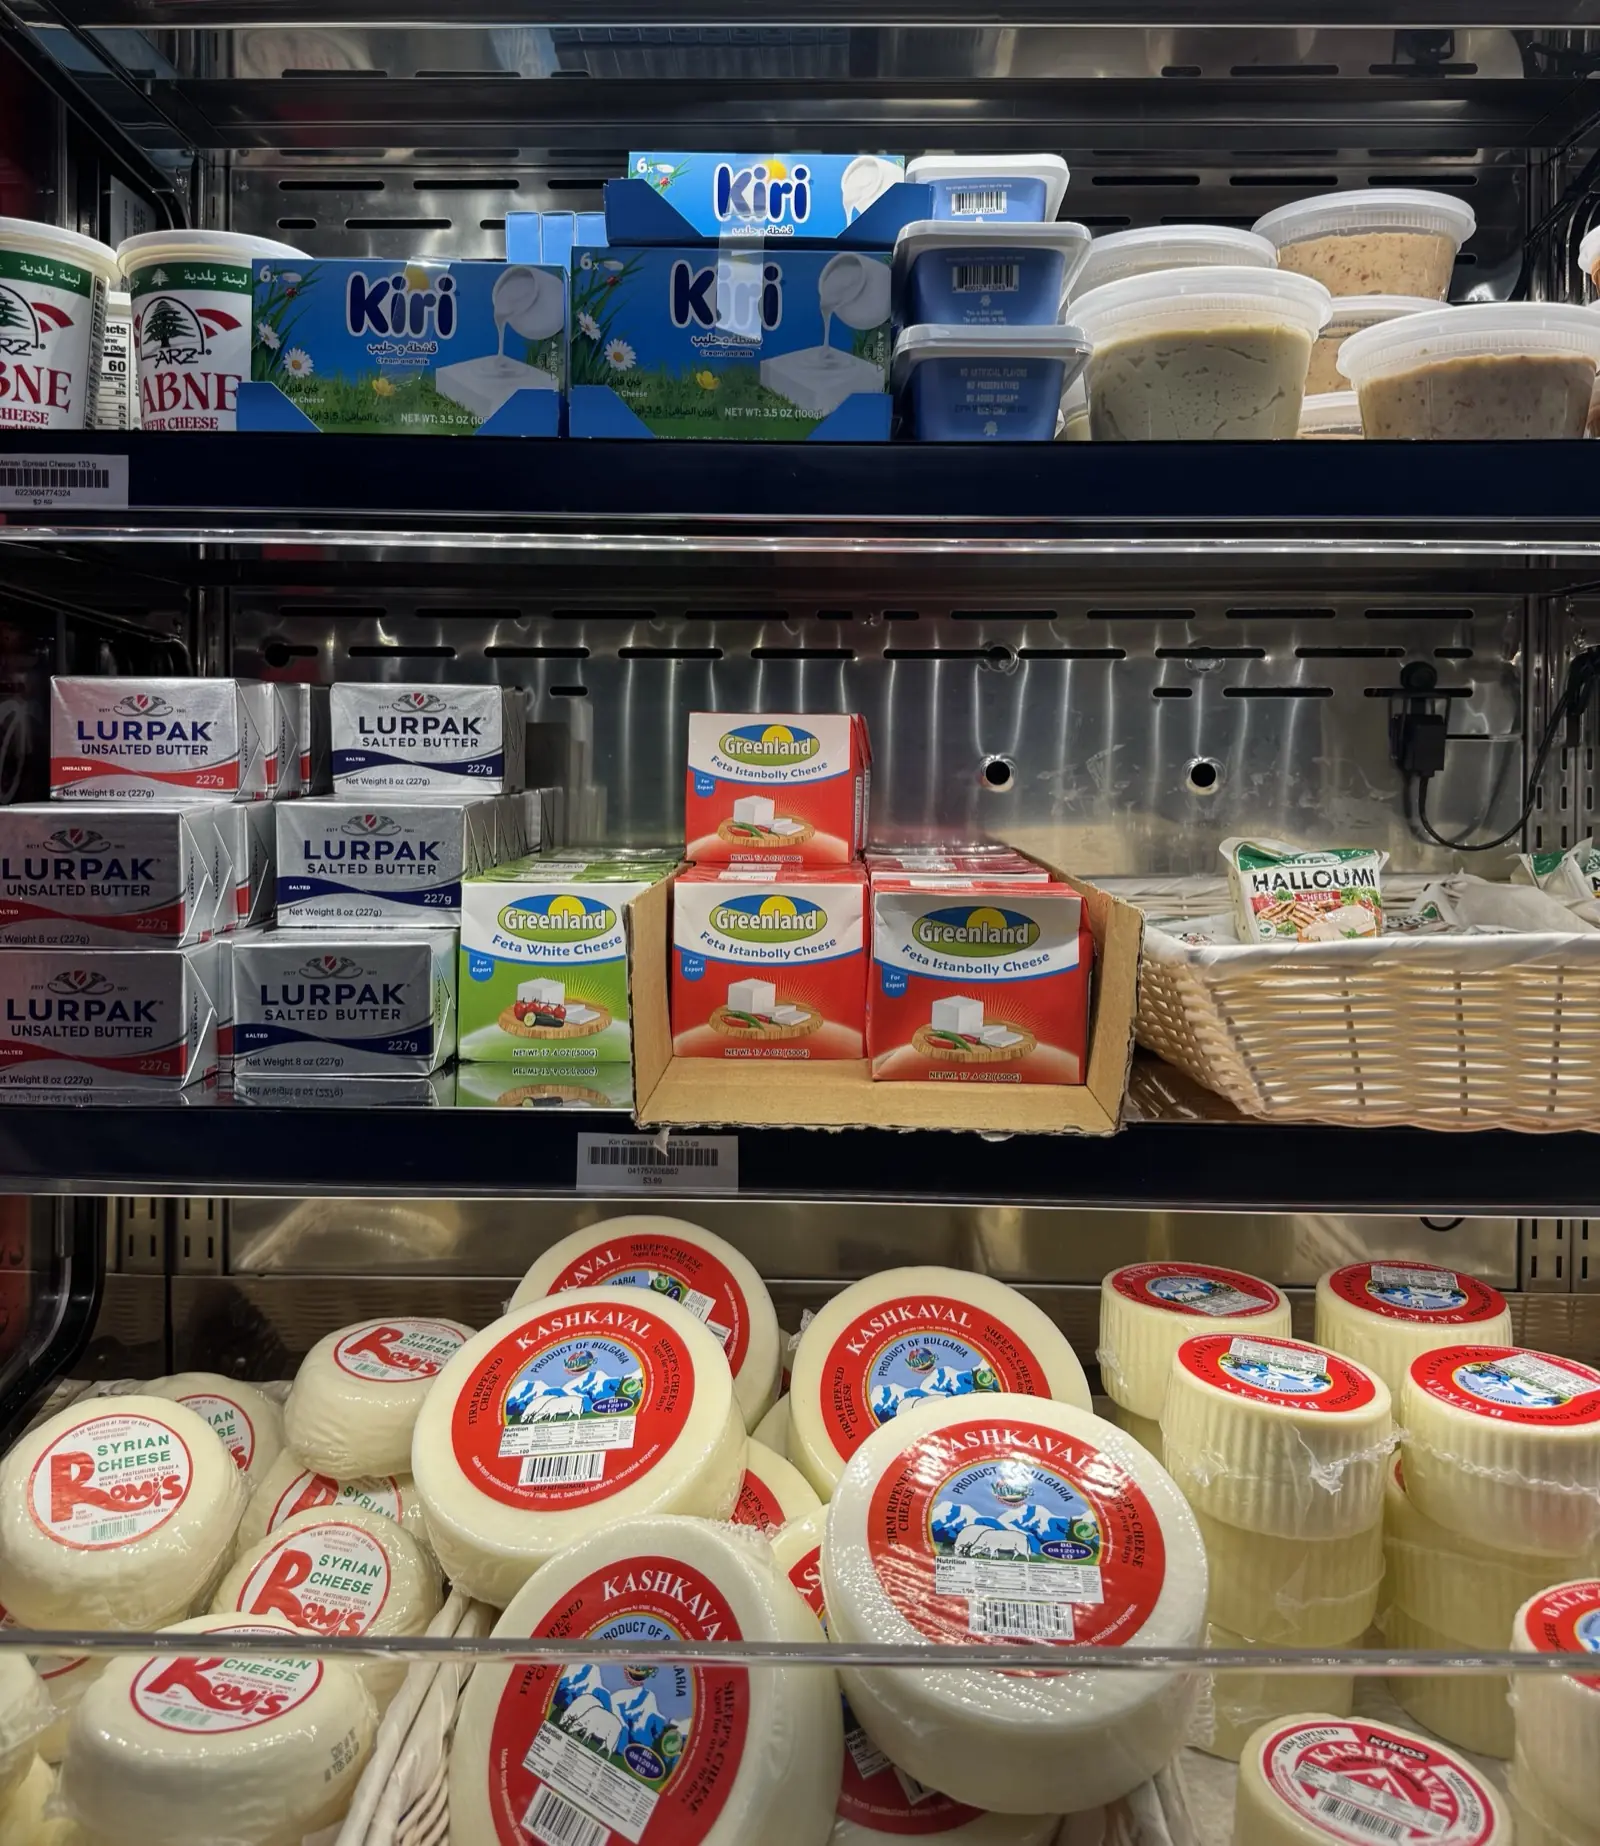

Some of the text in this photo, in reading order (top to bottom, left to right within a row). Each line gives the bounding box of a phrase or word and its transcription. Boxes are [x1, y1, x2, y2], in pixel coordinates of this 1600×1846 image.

[635, 157, 654, 174] 6x
[713, 162, 812, 223] Kiri
[20, 259, 81, 285] لبنة بلدية
[579, 253, 599, 270] 6x
[184, 268, 248, 286] لبنة بلدية
[259, 264, 279, 283] 6x
[346, 271, 458, 338] Kiri
[670, 259, 783, 331] Kiri
[155, 348, 199, 369] ARZ
[376, 356, 430, 366] Cream Milk
[700, 349, 724, 357] Cream
[108, 360, 126, 373] 60
[960, 368, 968, 377] NO
[621, 390, 648, 398] Cheese
[0, 408, 49, 426] HEESE
[401, 413, 469, 425] NET 3.5 OZ
[724, 407, 744, 417] NET
[763, 408, 778, 418] 3.5
[780, 408, 793, 418] OZ
[794, 408, 823, 420] (100g)
[77, 720, 213, 742] LURPAK
[359, 716, 483, 735] LURPAK
[82, 744, 209, 755] UNSALTED BUTTER
[362, 737, 479, 748] SALTED BUTTER
[724, 736, 812, 755] Greenland
[467, 764, 493, 775] 227g
[710, 755, 828, 781] Feta Istanbolly Cheese
[195, 774, 225, 786] 227g
[346, 777, 359, 785] Net
[360, 777, 387, 786] Weight
[388, 777, 394, 785] 8
[405, 777, 431, 787] (227g)
[63, 788, 77, 797] Net
[79, 788, 108, 799] Weight
[109, 788, 116, 797] 8
[128, 788, 155, 799] (227g)
[303, 840, 441, 861] LURPAK
[2, 858, 156, 881] LURPAK
[308, 863, 437, 875] SALTED BUTTER
[7, 884, 151, 896] UNSALTED BUTTER
[1252, 868, 1376, 892] HALLOUMI
[423, 893, 452, 905] 227g
[1301, 892, 1334, 901] CHEESE
[289, 908, 303, 917] Net
[305, 908, 335, 917] Weight
[336, 908, 342, 917] 8
[355, 908, 382, 917] (227g)
[504, 909, 607, 931] Greenland
[715, 909, 818, 930] Greenland
[136, 919, 168, 930] 227g
[918, 920, 1029, 944] Greenland
[5, 935, 37, 945] Weight
[60, 935, 90, 946] (227g)
[492, 934, 623, 957] Feta White Cheese
[700, 931, 837, 960] Feta Istanbolly Cheese
[902, 943, 1051, 976] Feta Istanbolly Cheese
[261, 983, 406, 1006] LURPAK
[7, 999, 158, 1023] LURPAK
[264, 1008, 401, 1021] SALTED BUTTER
[11, 1024, 153, 1038] UNSALTED BUTTER
[387, 1040, 418, 1052] 227g
[140, 1060, 171, 1072] 227g
[246, 1058, 261, 1066] Net
[262, 1057, 294, 1067] Weight
[295, 1058, 302, 1066] 8
[315, 1057, 344, 1067] (227g)
[9, 1075, 42, 1086] Weight
[63, 1075, 93, 1086] (227g)
[630, 1243, 704, 1271] SHEEP'S CHEESE
[408, 1331, 462, 1350] SYRIAN
[516, 1309, 652, 1351] KASHKAVAL
[846, 1303, 972, 1357] KASHKAVAL
[399, 1338, 451, 1356] CHEESE
[985, 1325, 1020, 1360] SHEEP'S
[530, 1345, 573, 1374] PRODUCT
[575, 1341, 590, 1350] OF
[591, 1341, 630, 1365] BULGARIA
[878, 1343, 906, 1378] PRODUCT
[907, 1338, 921, 1347] OF
[923, 1337, 969, 1358] BULGARIA
[1427, 1351, 1494, 1376] KASHKAVAL
[658, 1337, 681, 1414] SHEEP'S CHEESE
[468, 1357, 504, 1425] FIRM RIPENED
[479, 1374, 502, 1412] CHEESE
[1424, 1378, 1505, 1418] BALKAN
[833, 1366, 857, 1440] FIRM RIPENED
[844, 1382, 859, 1424] CHEESE
[97, 1434, 170, 1457] SYRIAN
[97, 1450, 171, 1473] CHEESE
[889, 1467, 915, 1514] RIPENED
[898, 1486, 916, 1532] CHEESE
[936, 1557, 967, 1566] Nutrition
[1047, 1547, 1086, 1555] 0812019
[318, 1554, 383, 1578] SYRIAN
[309, 1572, 374, 1596] CHEESE
[223, 1658, 300, 1683] CHEESE
[537, 1731, 552, 1745] Facts
[542, 1721, 563, 1742] Nutrition
[1278, 1728, 1340, 1755] FIRM RIPENED
[688, 1680, 735, 1816] SHEEP'S CHEESE
[1309, 1743, 1454, 1812] KASHKAVAL
